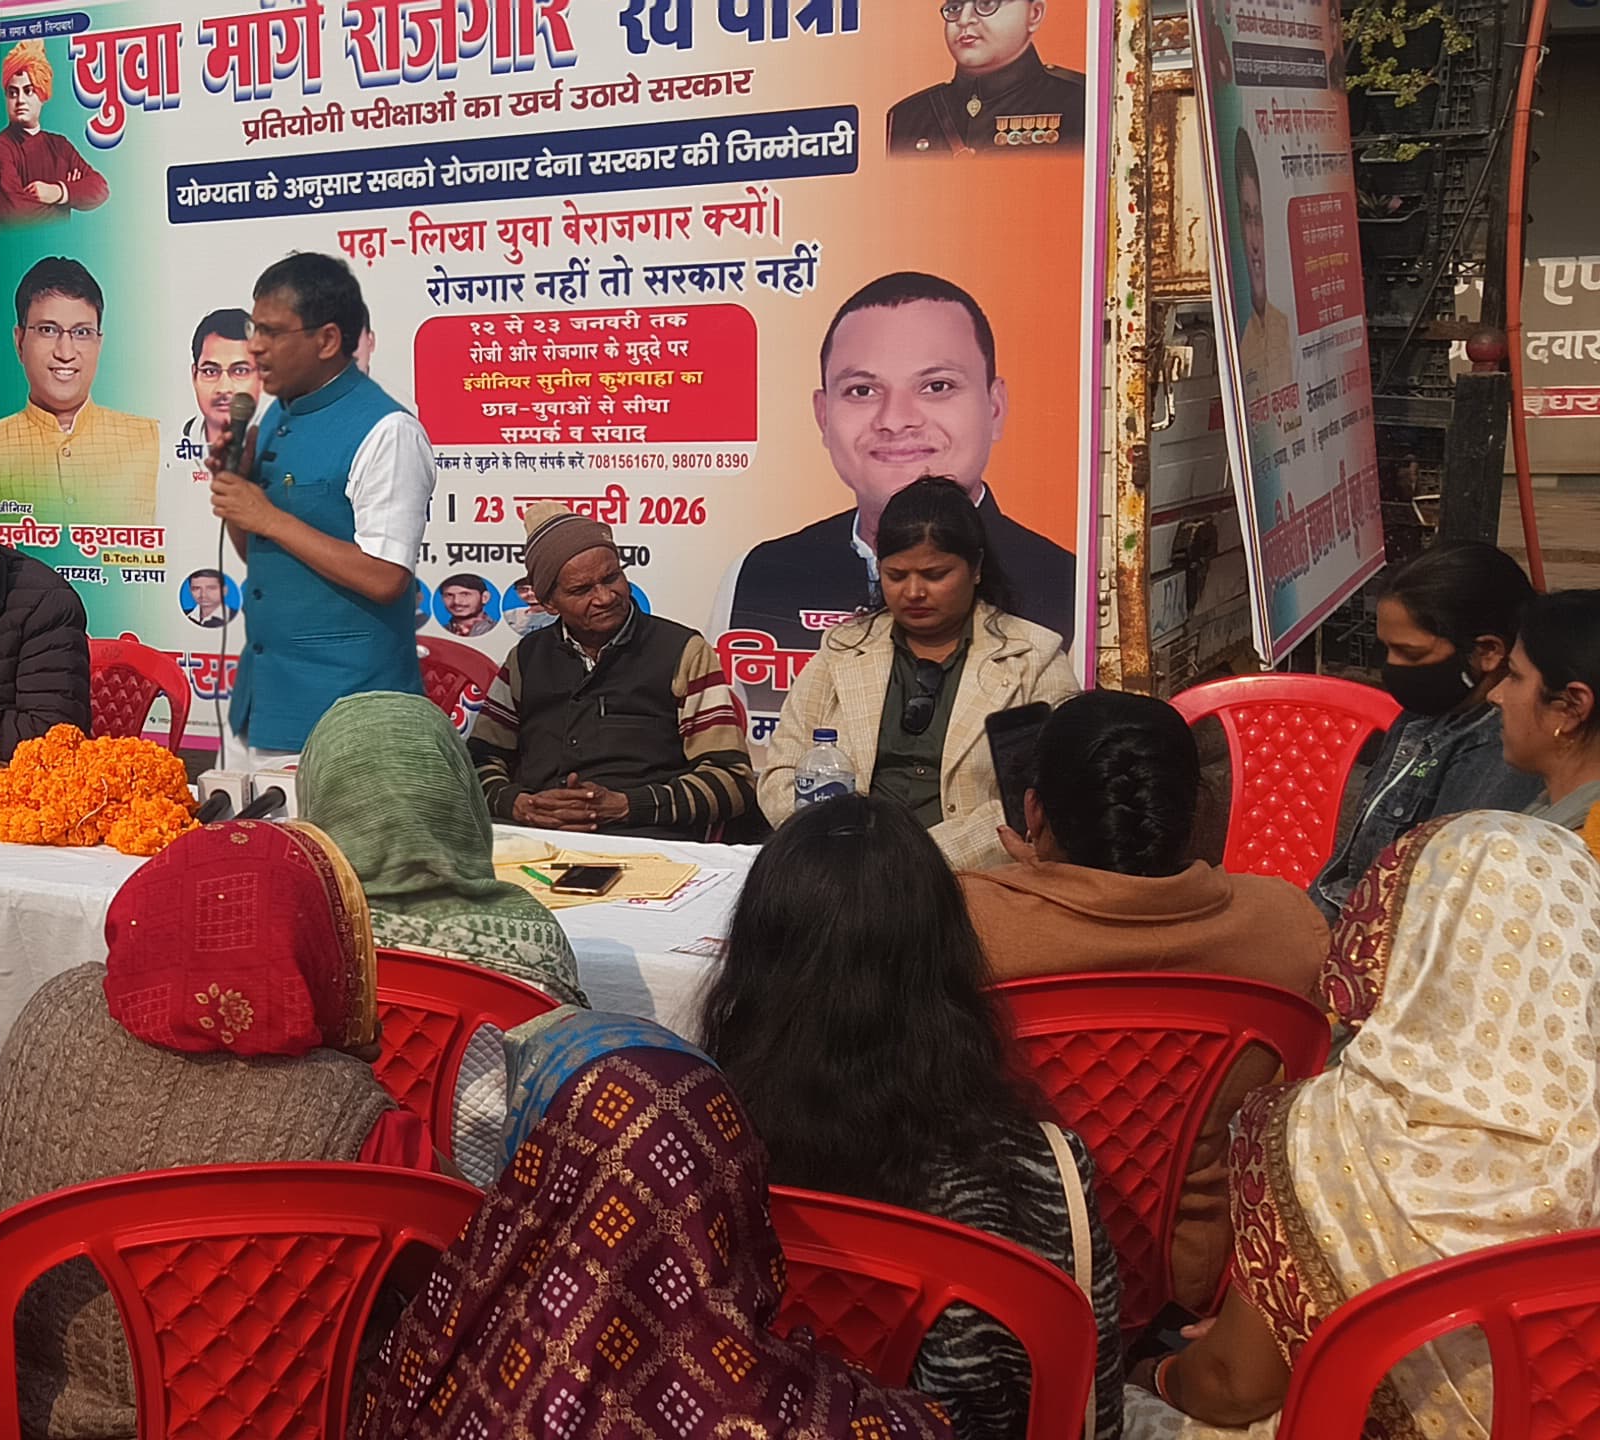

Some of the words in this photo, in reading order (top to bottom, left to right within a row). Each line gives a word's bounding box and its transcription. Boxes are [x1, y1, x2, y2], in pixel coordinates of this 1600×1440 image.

[71, 22, 182, 147] युवा
[243, 102, 344, 145] प्रतियोगी
[351, 91, 455, 130] परीक्षाओं
[464, 95, 501, 119] का
[510, 79, 563, 117] खर्च
[570, 72, 641, 110] उठाये
[648, 70, 754, 102] सरकार
[178, 179, 250, 207] योग्यता
[255, 171, 279, 201] के
[283, 172, 362, 208] अनुसार
[366, 158, 435, 192] सबको
[440, 157, 531, 186] रोजगार
[536, 148, 583, 179] देना
[588, 145, 678, 176] सरकार
[683, 133, 720, 167] की
[726, 121, 855, 164] जिम्मेदारी
[338, 210, 487, 267] पढ़ा-लिखा
[496, 216, 552, 265] युवा
[427, 265, 525, 306] रोजगार
[535, 257, 590, 304] नहीं
[600, 255, 633, 298] तो
[643, 261, 745, 295] सरकार
[756, 243, 819, 294] नहीं
[469, 320, 496, 336] १२
[504, 314, 525, 335] से
[533, 317, 561, 334] २३
[569, 309, 641, 332] जनवरी
[649, 311, 688, 328] तक
[469, 340, 502, 363] रोजी
[508, 338, 537, 363] और
[543, 337, 598, 361] रोजगार
[604, 337, 620, 359] के
[667, 338, 689, 357] पर
[536, 369, 591, 395] सुनील
[599, 370, 673, 393] कुशवाहा
[680, 370, 704, 385] का
[481, 395, 591, 421] छात्र-युवाओं
[598, 396, 616, 415] से
[623, 394, 670, 415] सीधा
[500, 421, 561, 443] सम्पर्क
[569, 426, 583, 442] व
[591, 420, 647, 443] संवाद
[463, 454, 472, 469] से
[503, 453, 512, 469] के
[515, 453, 537, 471] लिए
[540, 452, 565, 470] संपर्क
[568, 451, 584, 469] करें
[588, 454, 668, 471] 7081561670,
[672, 453, 712, 468] 98070
[716, 453, 748, 468] 8390
[474, 497, 505, 523] 23
[639, 497, 707, 525] 2026
[71, 527, 166, 555] कुशवाहा
[144, 554, 165, 564] LLB
[121, 569, 166, 583] प्रसपा
